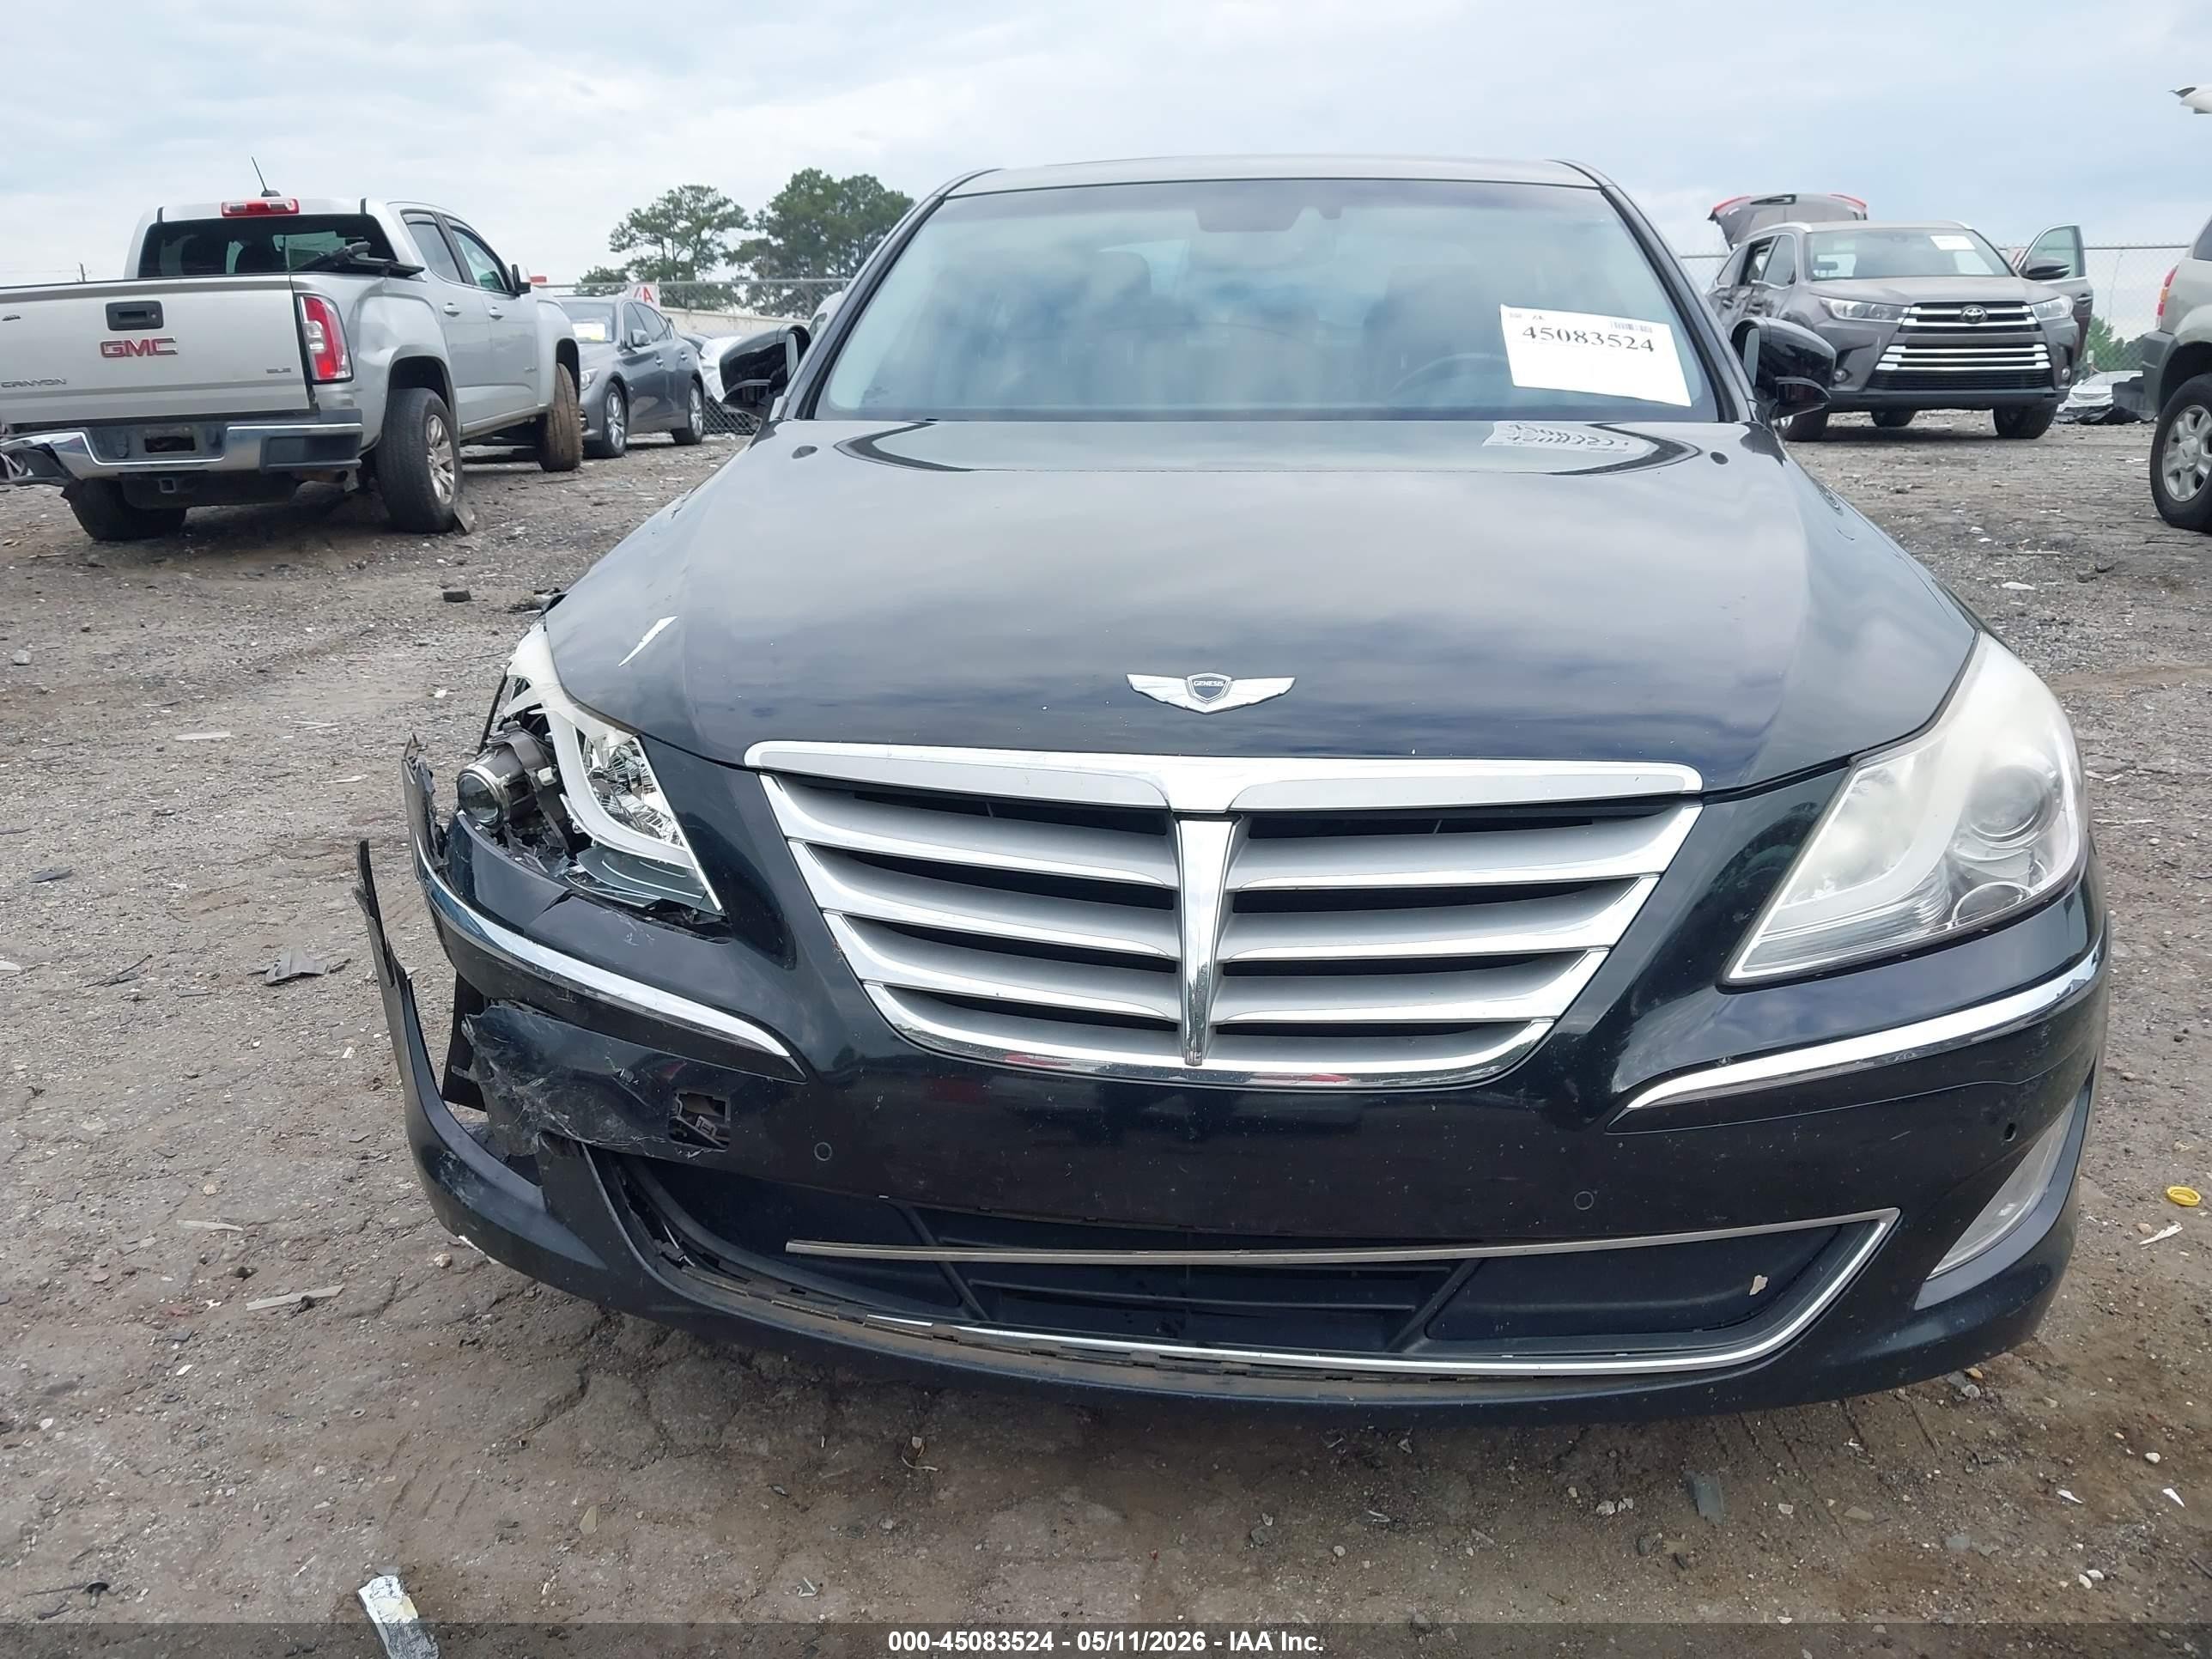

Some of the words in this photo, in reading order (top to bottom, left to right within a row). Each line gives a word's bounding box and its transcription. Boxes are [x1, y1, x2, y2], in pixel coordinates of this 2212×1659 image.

[100, 337, 178, 357] GMC
[1522, 325, 1655, 352] 45083524
[0, 378, 67, 387] CANYON
